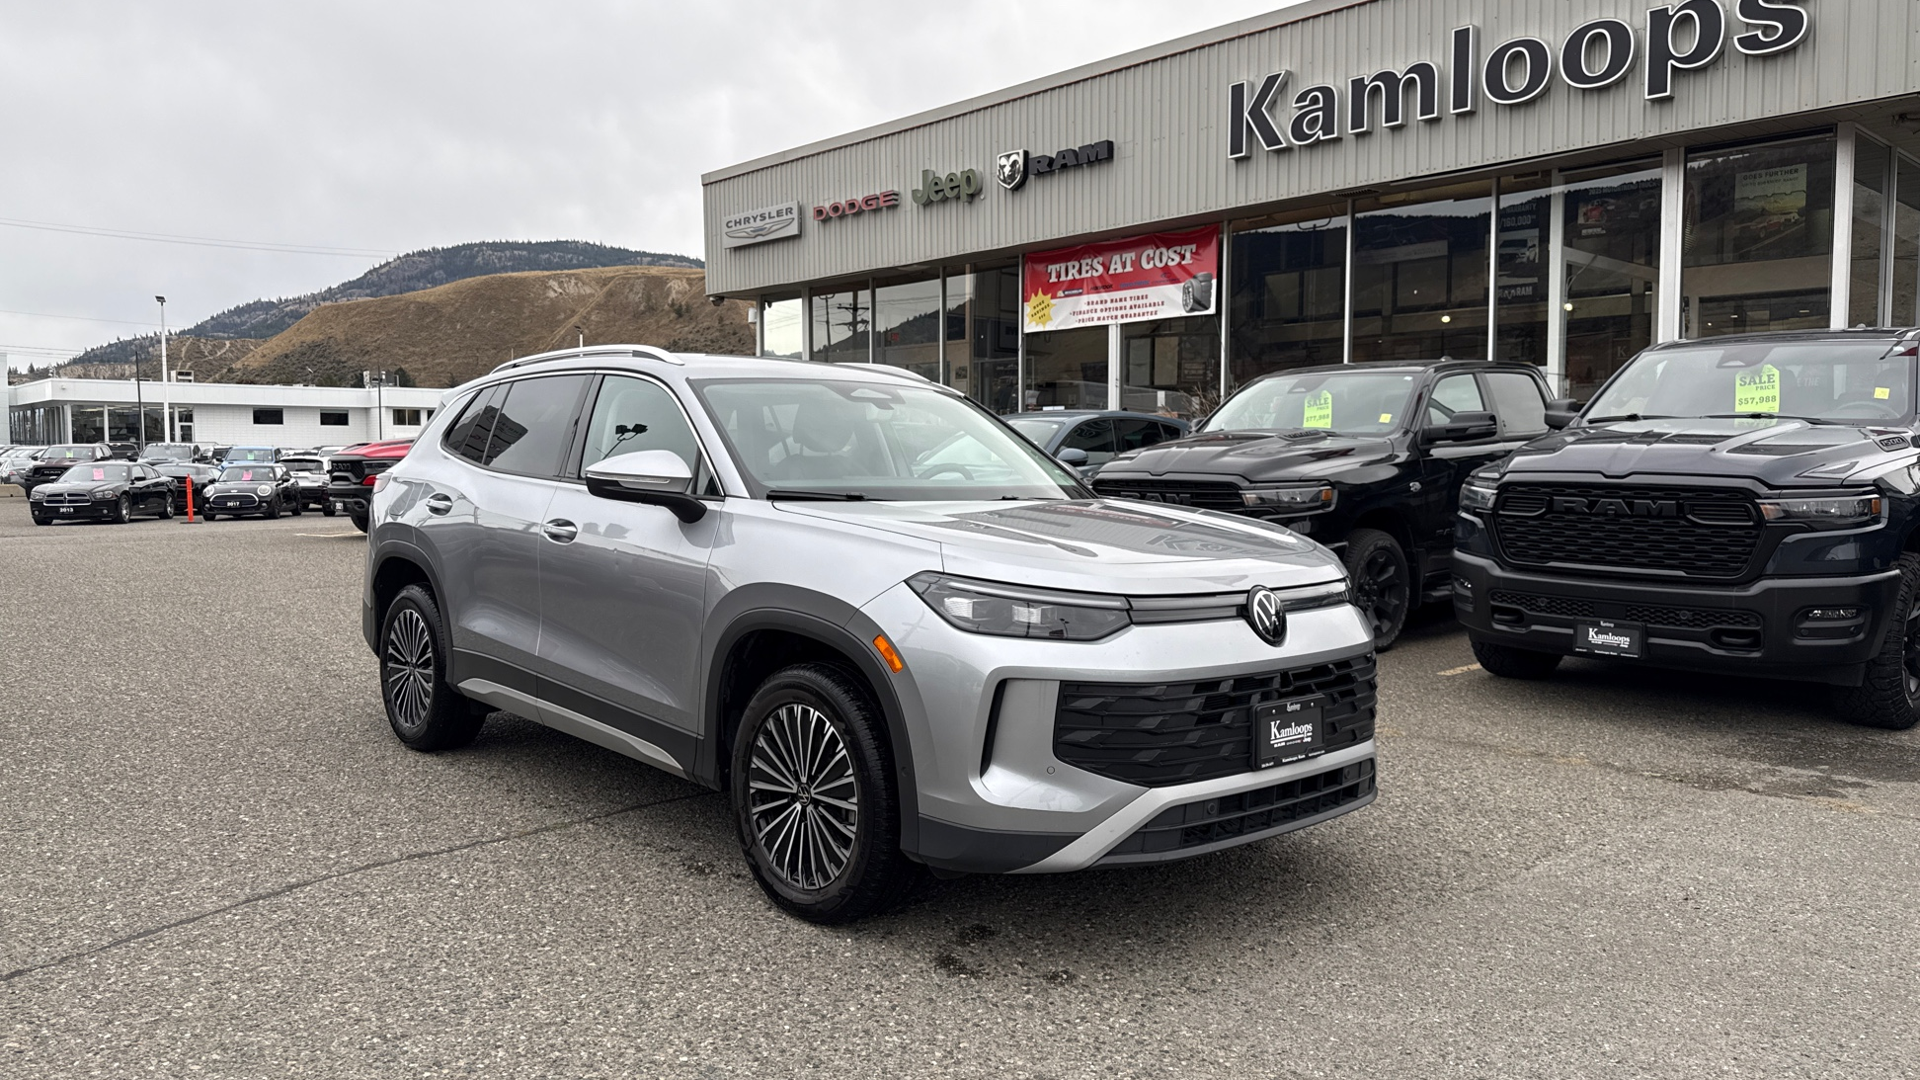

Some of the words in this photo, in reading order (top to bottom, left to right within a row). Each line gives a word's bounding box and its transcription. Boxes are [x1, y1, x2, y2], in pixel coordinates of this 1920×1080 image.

[1228, 0, 1811, 160] Kamloops
[1028, 139, 1114, 176] RAM
[1742, 173, 1763, 181] GOES
[1764, 168, 1799, 178] FURTHER
[911, 168, 985, 206] Jeep
[813, 189, 898, 222] DODGE
[725, 206, 794, 230] CHRYSLER
[1048, 257, 1103, 283] TIRES
[1108, 251, 1136, 275] AT
[1140, 244, 1197, 270] COST
[1515, 286, 1533, 296] RAM
[1099, 304, 1129, 314] OPTIONS
[1129, 301, 1165, 311] AVAILABLE
[1096, 313, 1119, 322] MATCH
[1739, 374, 1775, 386] SALE
[1307, 397, 1329, 408] SALE
[1738, 395, 1777, 406] $57,988
[1881, 437, 1902, 447] 1500
[1552, 496, 1677, 517] RAM
[1588, 628, 1630, 645] Kamloops
[1270, 720, 1313, 740] Kamloops
